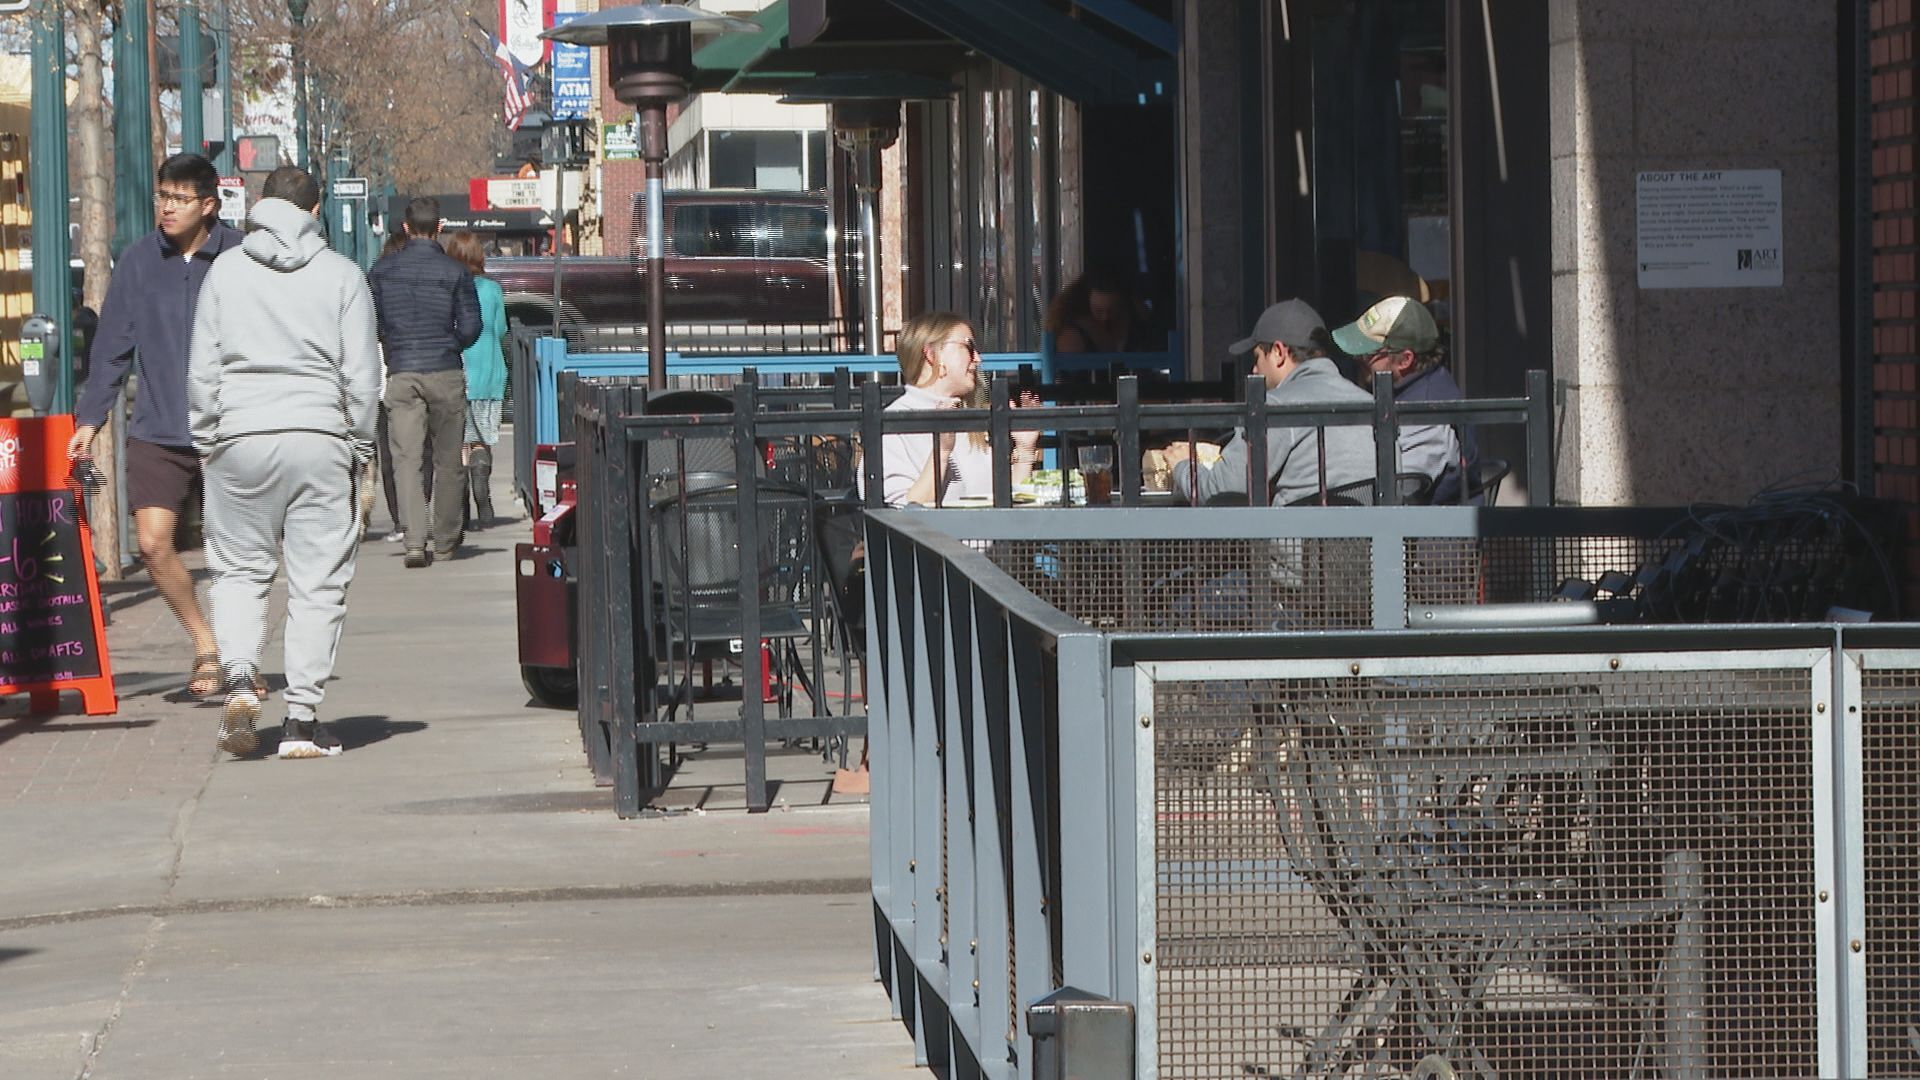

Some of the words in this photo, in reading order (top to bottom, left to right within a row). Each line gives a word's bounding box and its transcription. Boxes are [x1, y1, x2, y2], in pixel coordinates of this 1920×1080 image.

[558, 83, 590, 97] ATM
[219, 178, 241, 186] NOTICE
[1640, 173, 1675, 182] ABOUT
[1680, 173, 1698, 181] THE
[1702, 172, 1723, 181] ART
[1753, 248, 1778, 260] ART
[16, 497, 73, 525] HOUR
